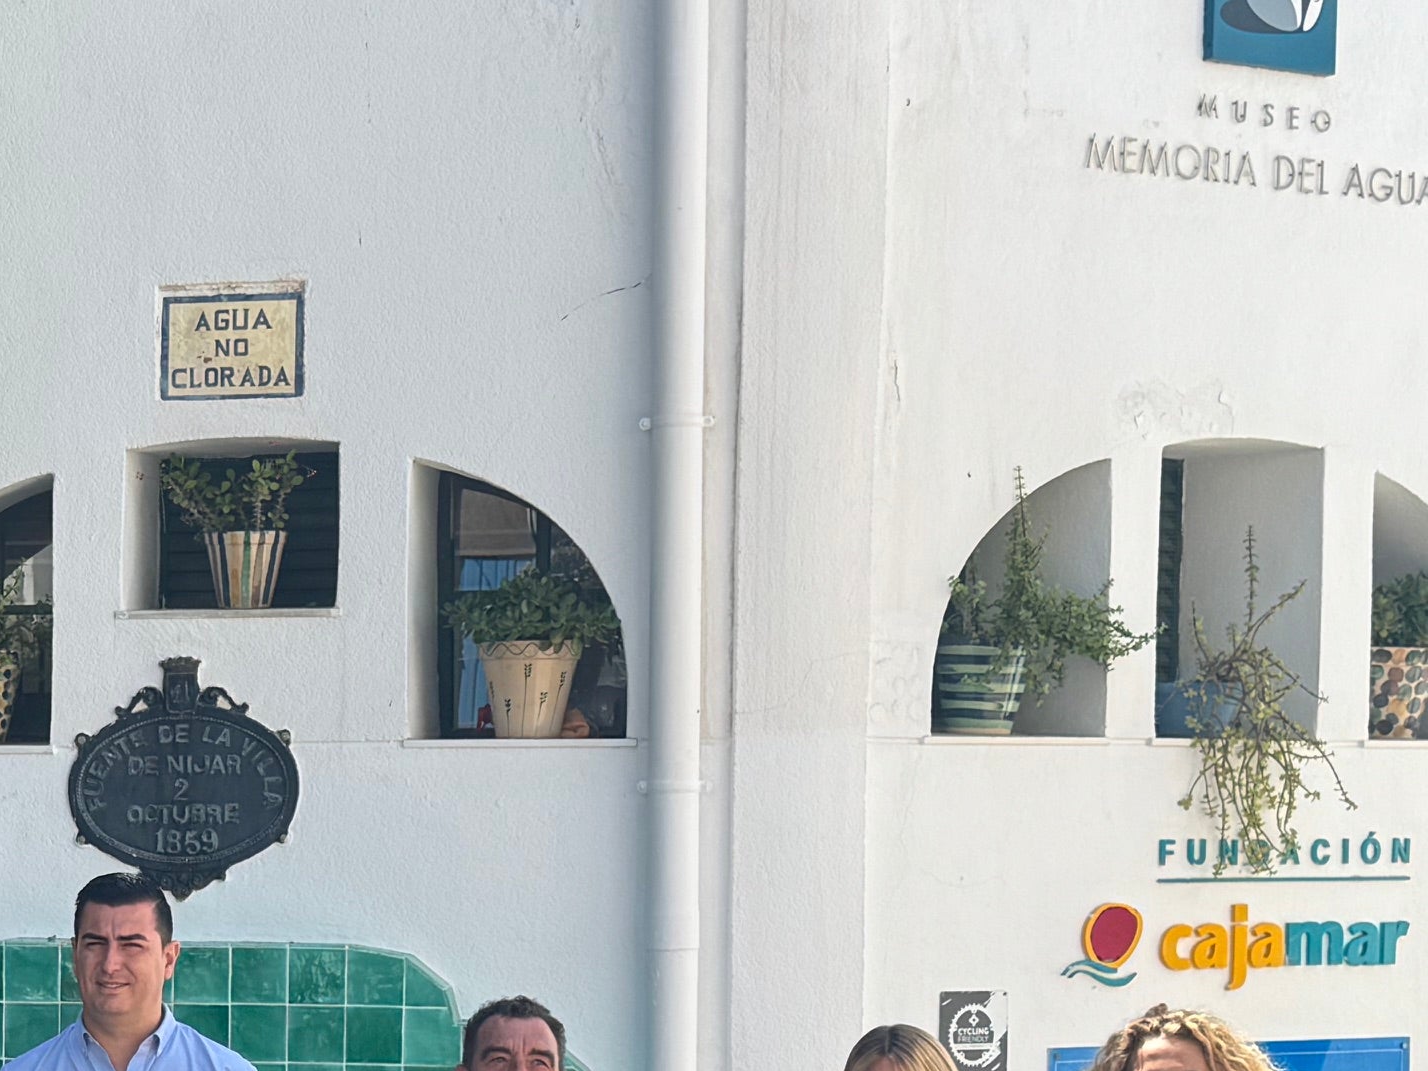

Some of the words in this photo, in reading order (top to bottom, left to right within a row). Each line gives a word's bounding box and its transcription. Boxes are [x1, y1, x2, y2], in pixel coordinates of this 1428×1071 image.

[1197, 94, 1331, 132] MUSEO
[1086, 132, 1257, 187] MEMORIA
[1273, 154, 1330, 195] DEL
[195, 308, 272, 331] AGUA
[214, 338, 249, 357] NO
[172, 365, 291, 389] CLORADA
[82, 729, 148, 812] FUENTE
[158, 724, 190, 744] DE
[202, 726, 232, 747] LA
[242, 737, 284, 809] VILLA
[128, 756, 159, 775] DE
[168, 755, 241, 775] NIJAR
[174, 778, 189, 800] 2
[127, 803, 240, 824] OCTUBRE
[155, 828, 219, 854] 1859
[1158, 831, 1411, 866] FUNDACIÓN
[1160, 904, 1410, 991] cajamar
[958, 1027, 989, 1036] CYCLING
